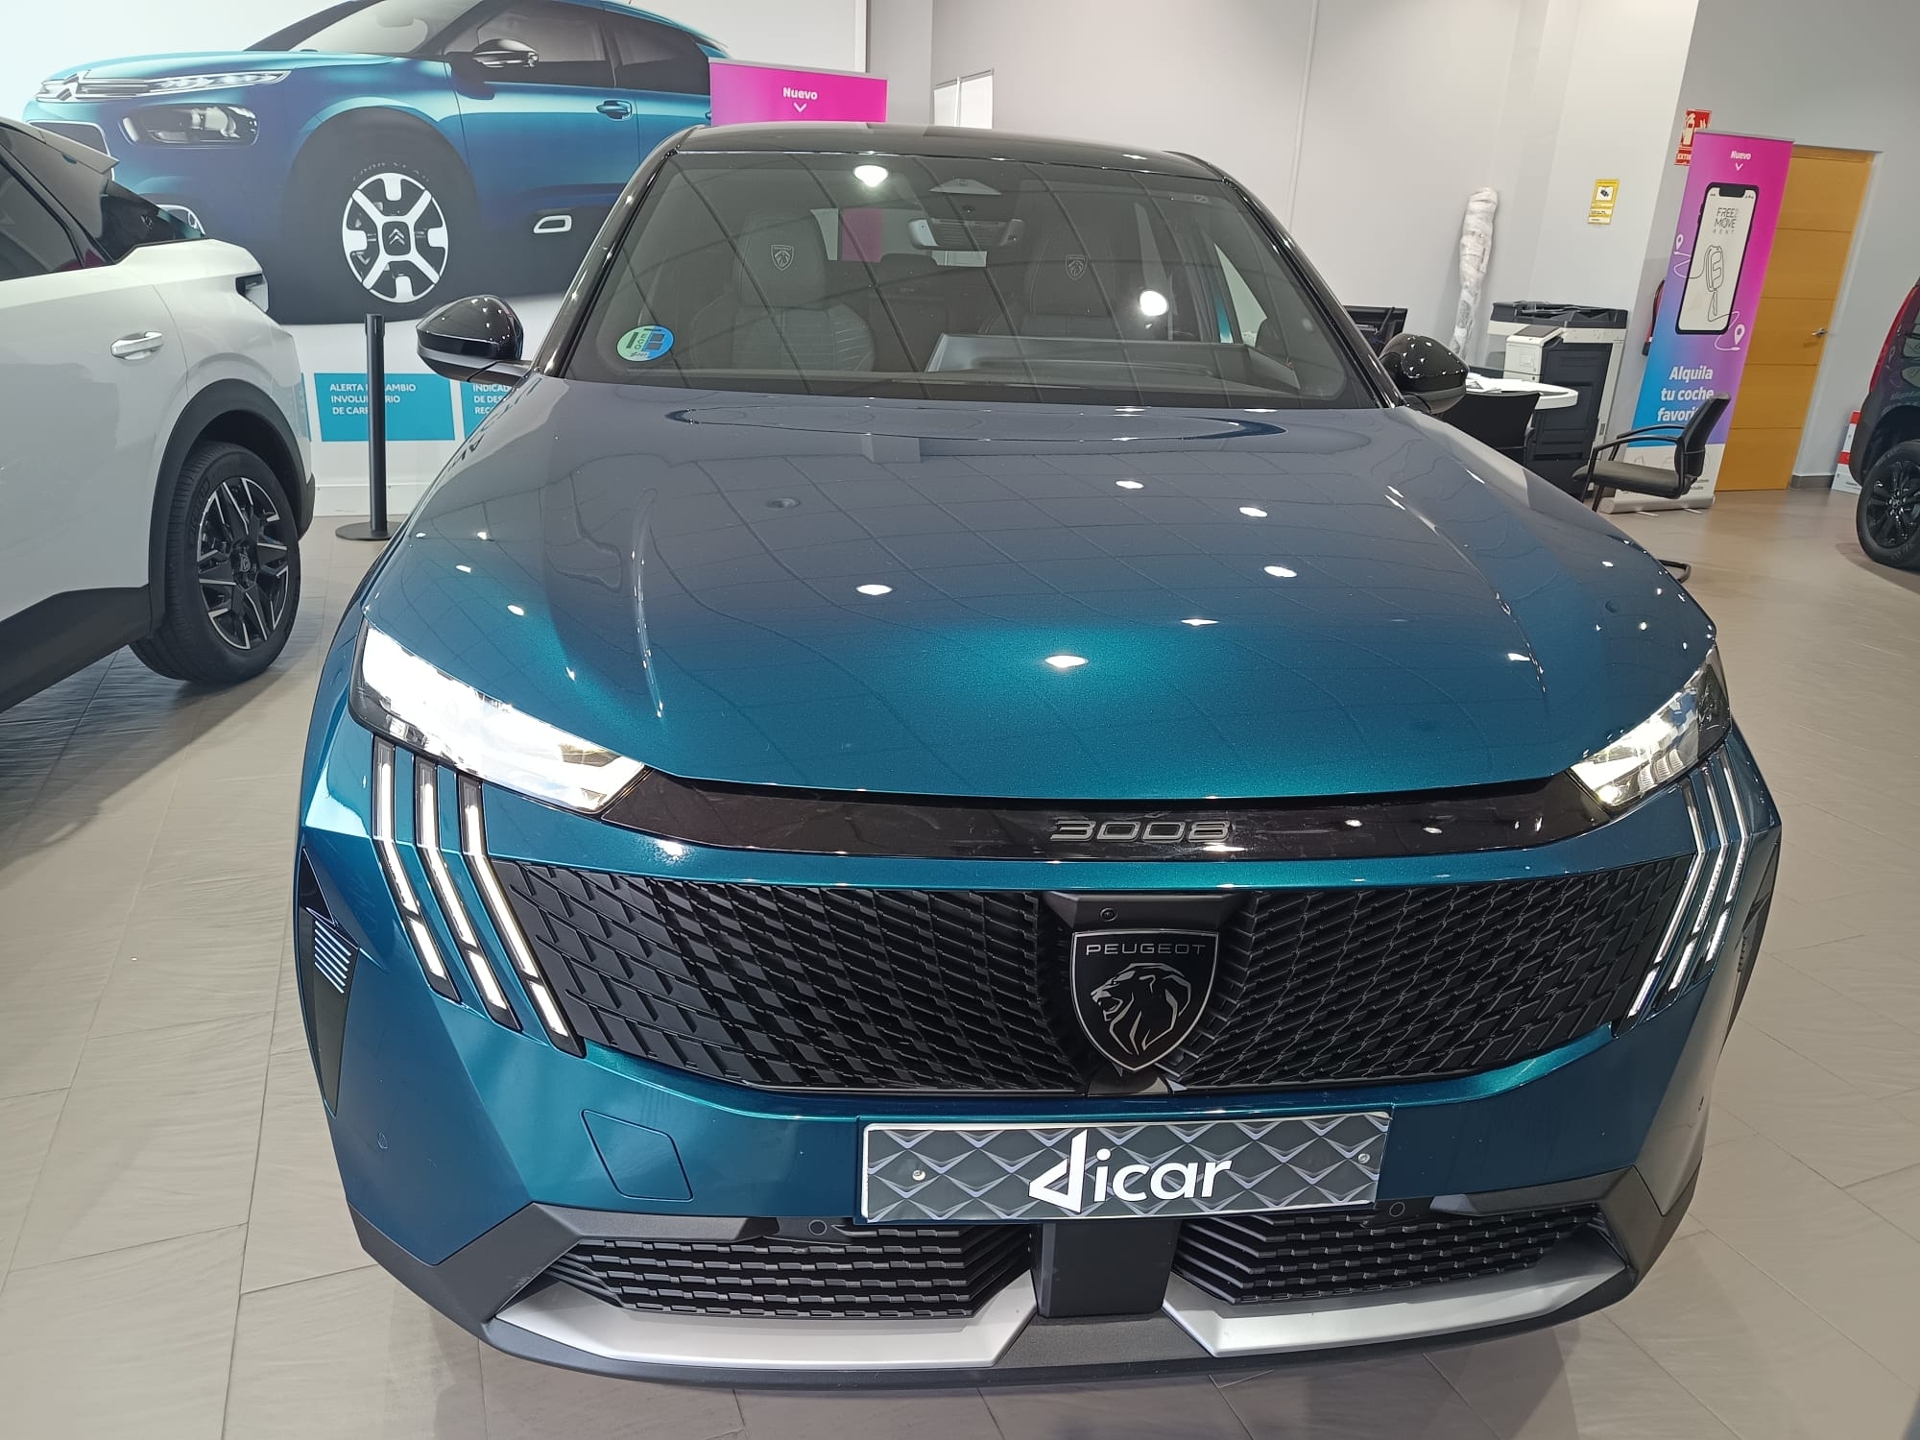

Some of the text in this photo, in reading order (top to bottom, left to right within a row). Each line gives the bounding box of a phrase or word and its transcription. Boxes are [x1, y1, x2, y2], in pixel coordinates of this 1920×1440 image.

[782, 86, 818, 101] Nuevo
[1729, 150, 1752, 161] Nuevo
[1714, 217, 1737, 229] MOVE
[1668, 365, 1714, 383] Alquila
[329, 383, 364, 392] ALERTA
[384, 383, 417, 392] AMBIO
[472, 383, 511, 393] INDICAD
[1661, 386, 1715, 401] tu coche
[331, 395, 401, 404] INVOLURIO
[473, 395, 503, 404] DE DES
[332, 406, 345, 415] DE
[474, 406, 492, 415] REC
[1657, 406, 1699, 422] favori
[1050, 820, 1231, 843] 3008
[1086, 943, 1206, 956] PEUGEOT
[1028, 1128, 1233, 1214] dicar
